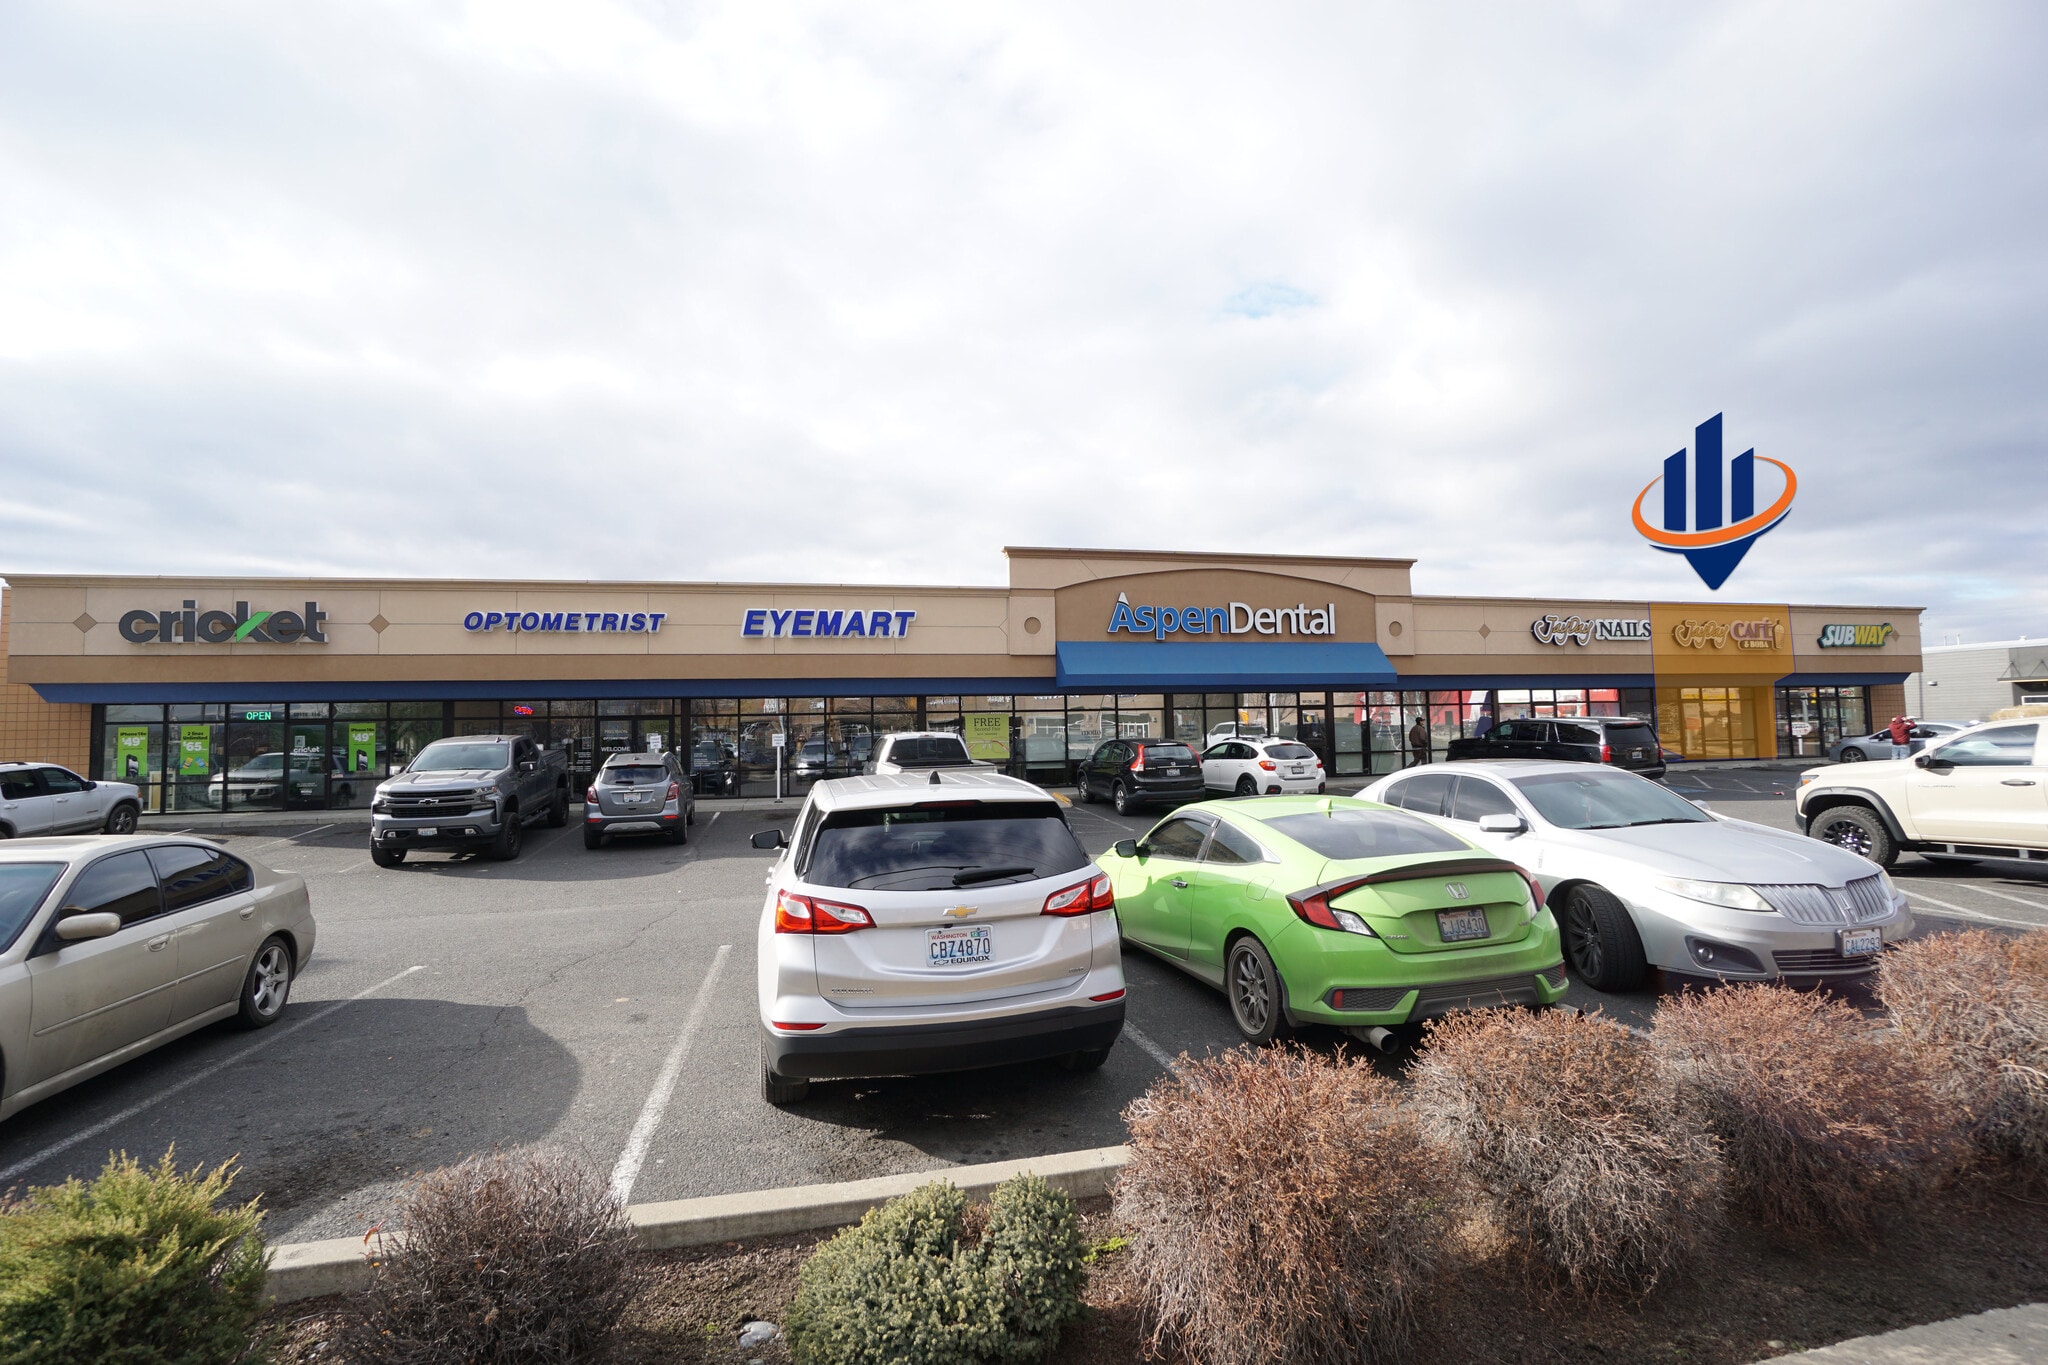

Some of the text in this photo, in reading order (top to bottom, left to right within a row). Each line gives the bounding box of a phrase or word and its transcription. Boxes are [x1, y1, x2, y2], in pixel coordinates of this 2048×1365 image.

[119, 600, 328, 643] cricket
[464, 611, 666, 634] OPTOMETRIST
[742, 609, 917, 637] EYEMART
[1599, 621, 1651, 637] NAILS
[1823, 625, 1889, 646] SUBWAY
[246, 711, 271, 720] OPEN
[974, 717, 1001, 727] FREE
[931, 932, 968, 940] WASHINGTON
[930, 938, 991, 959] CBZ4870
[951, 955, 990, 964] EQUINOX
